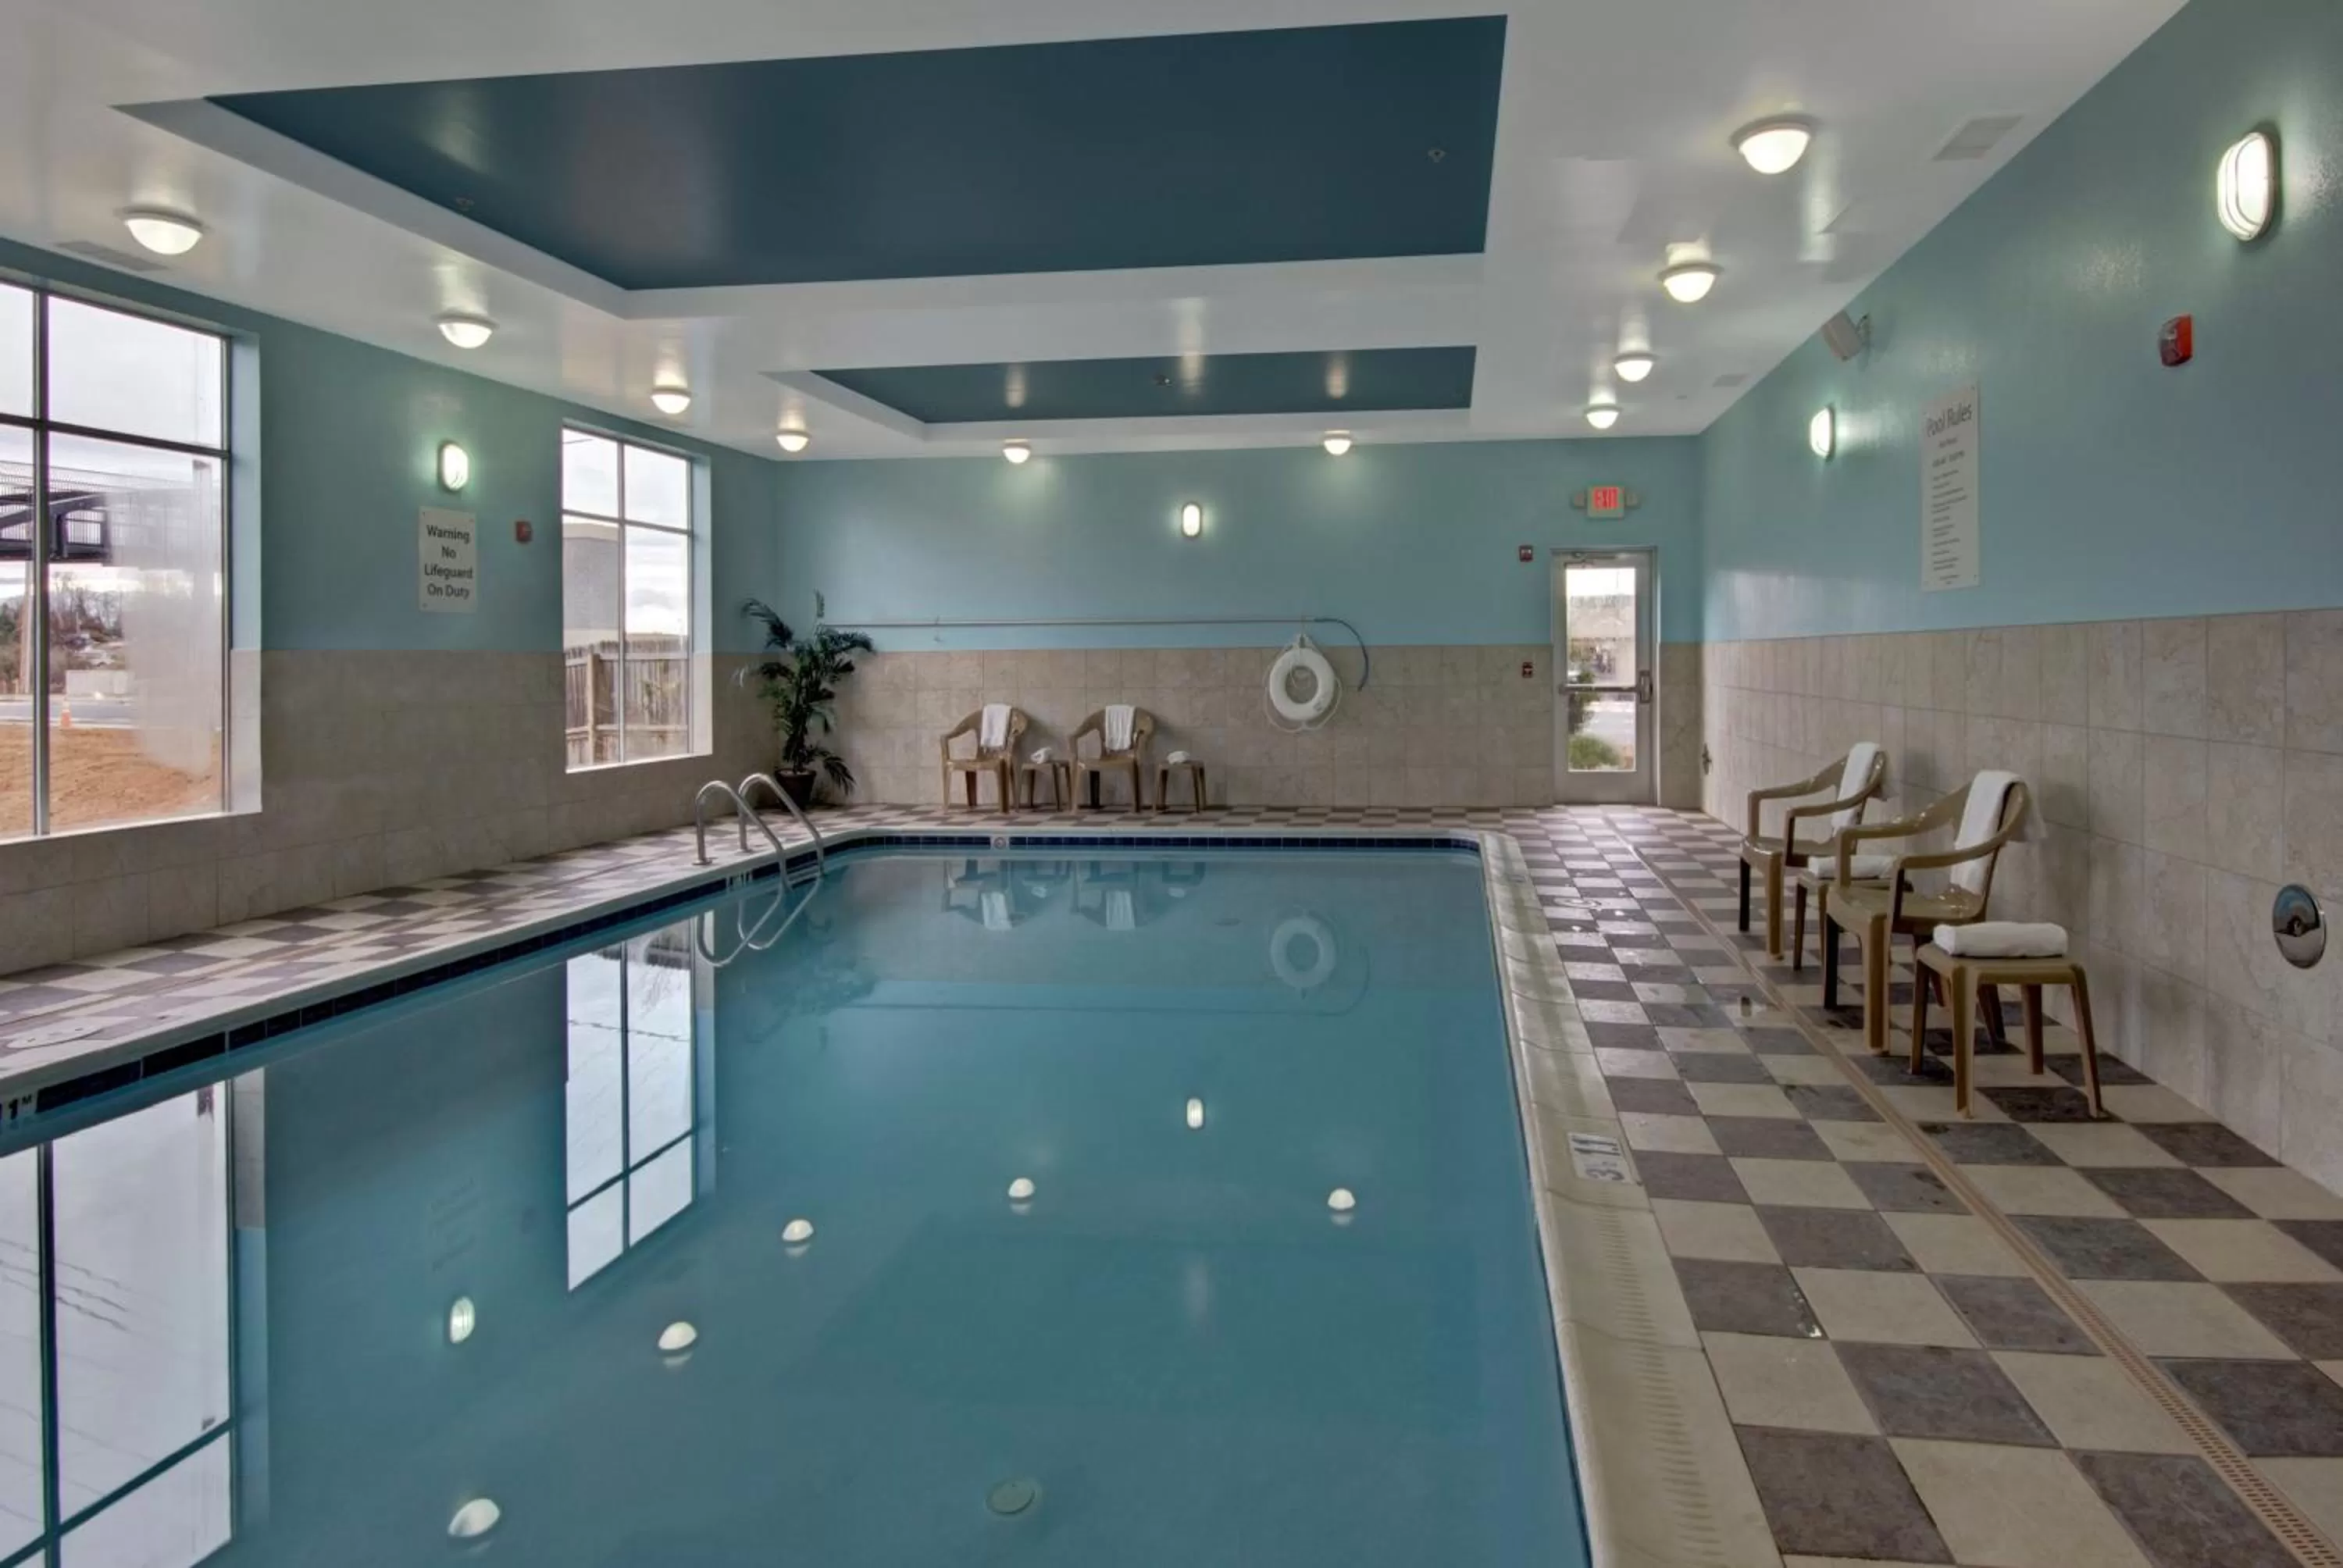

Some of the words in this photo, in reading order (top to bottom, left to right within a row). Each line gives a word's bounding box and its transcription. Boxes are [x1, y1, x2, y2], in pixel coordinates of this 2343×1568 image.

[1927, 410, 1945, 437] Pool
[1947, 402, 1972, 428] Rules
[1593, 487, 1619, 509] EXIT
[426, 525, 470, 544] Warning
[442, 546, 457, 559] No
[424, 564, 473, 580] Lifeguard
[427, 583, 444, 597] On
[445, 585, 470, 600] Duty
